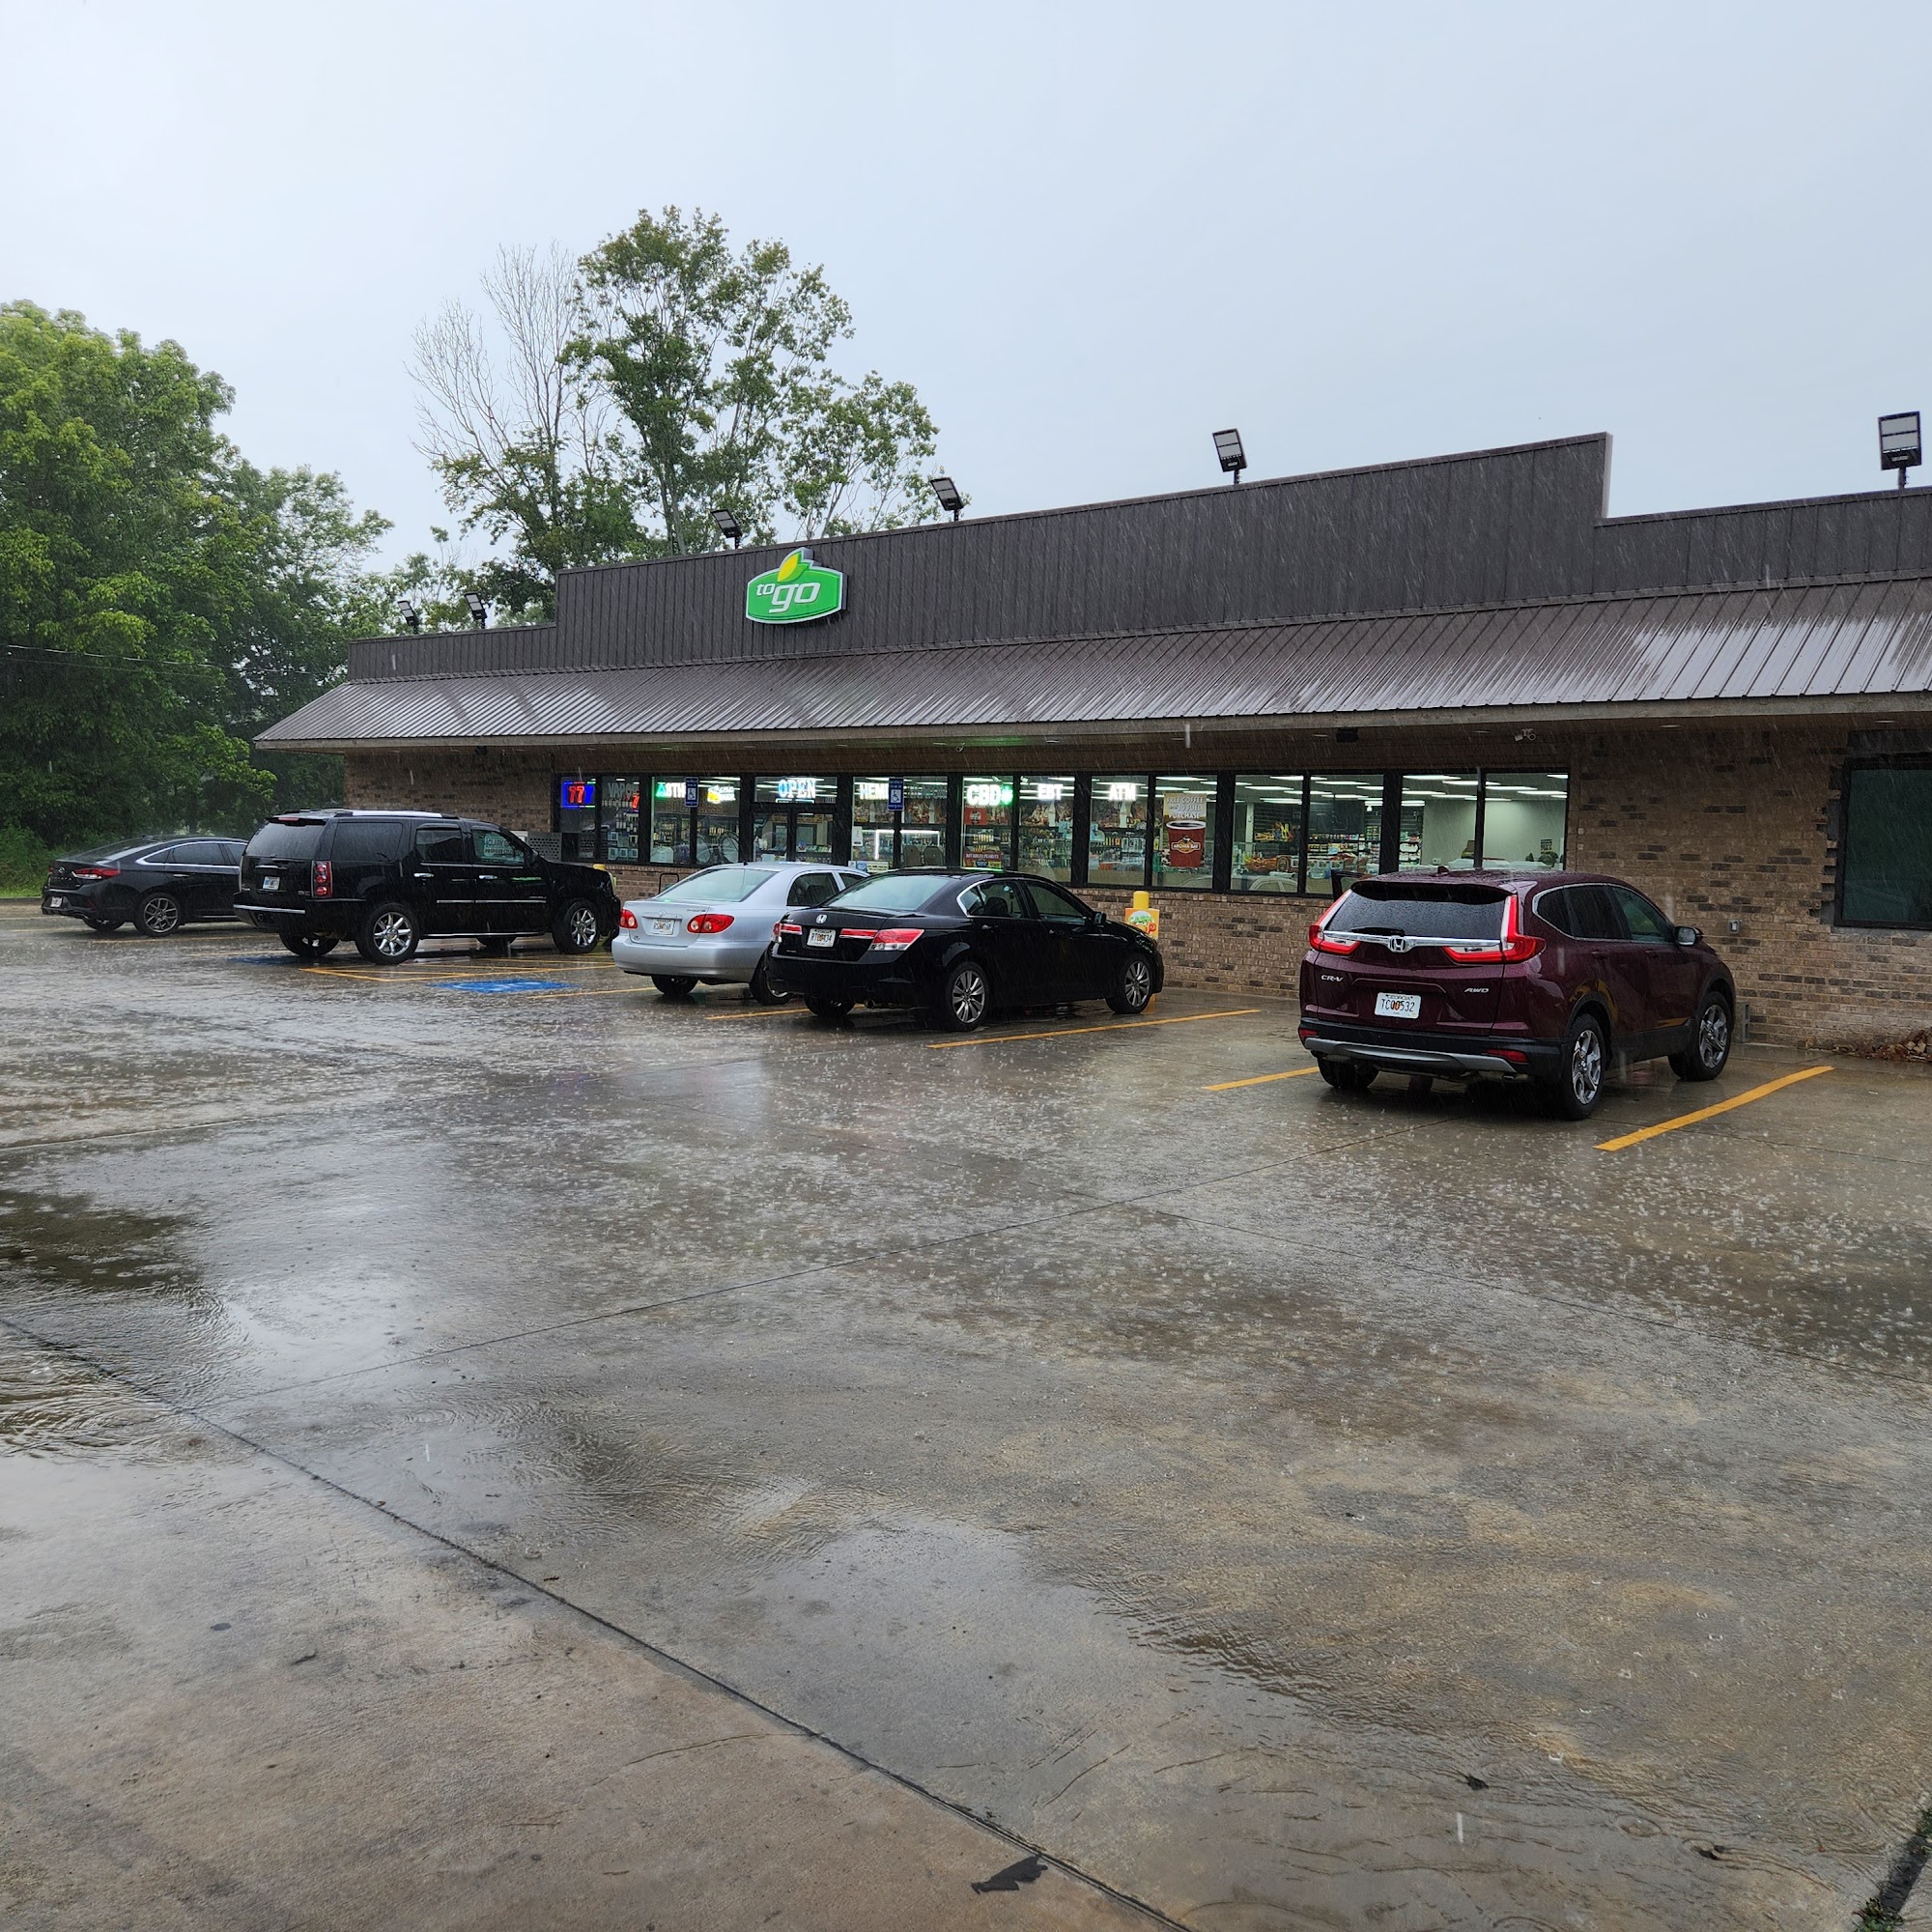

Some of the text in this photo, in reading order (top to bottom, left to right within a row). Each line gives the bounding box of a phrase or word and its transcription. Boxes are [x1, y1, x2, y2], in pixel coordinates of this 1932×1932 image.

[778, 779, 816, 799] OPEN
[967, 784, 1001, 806] CBD
[1037, 783, 1063, 800] EBT
[1108, 783, 1137, 801] ATM
[1181, 796, 1205, 805] COFFEE
